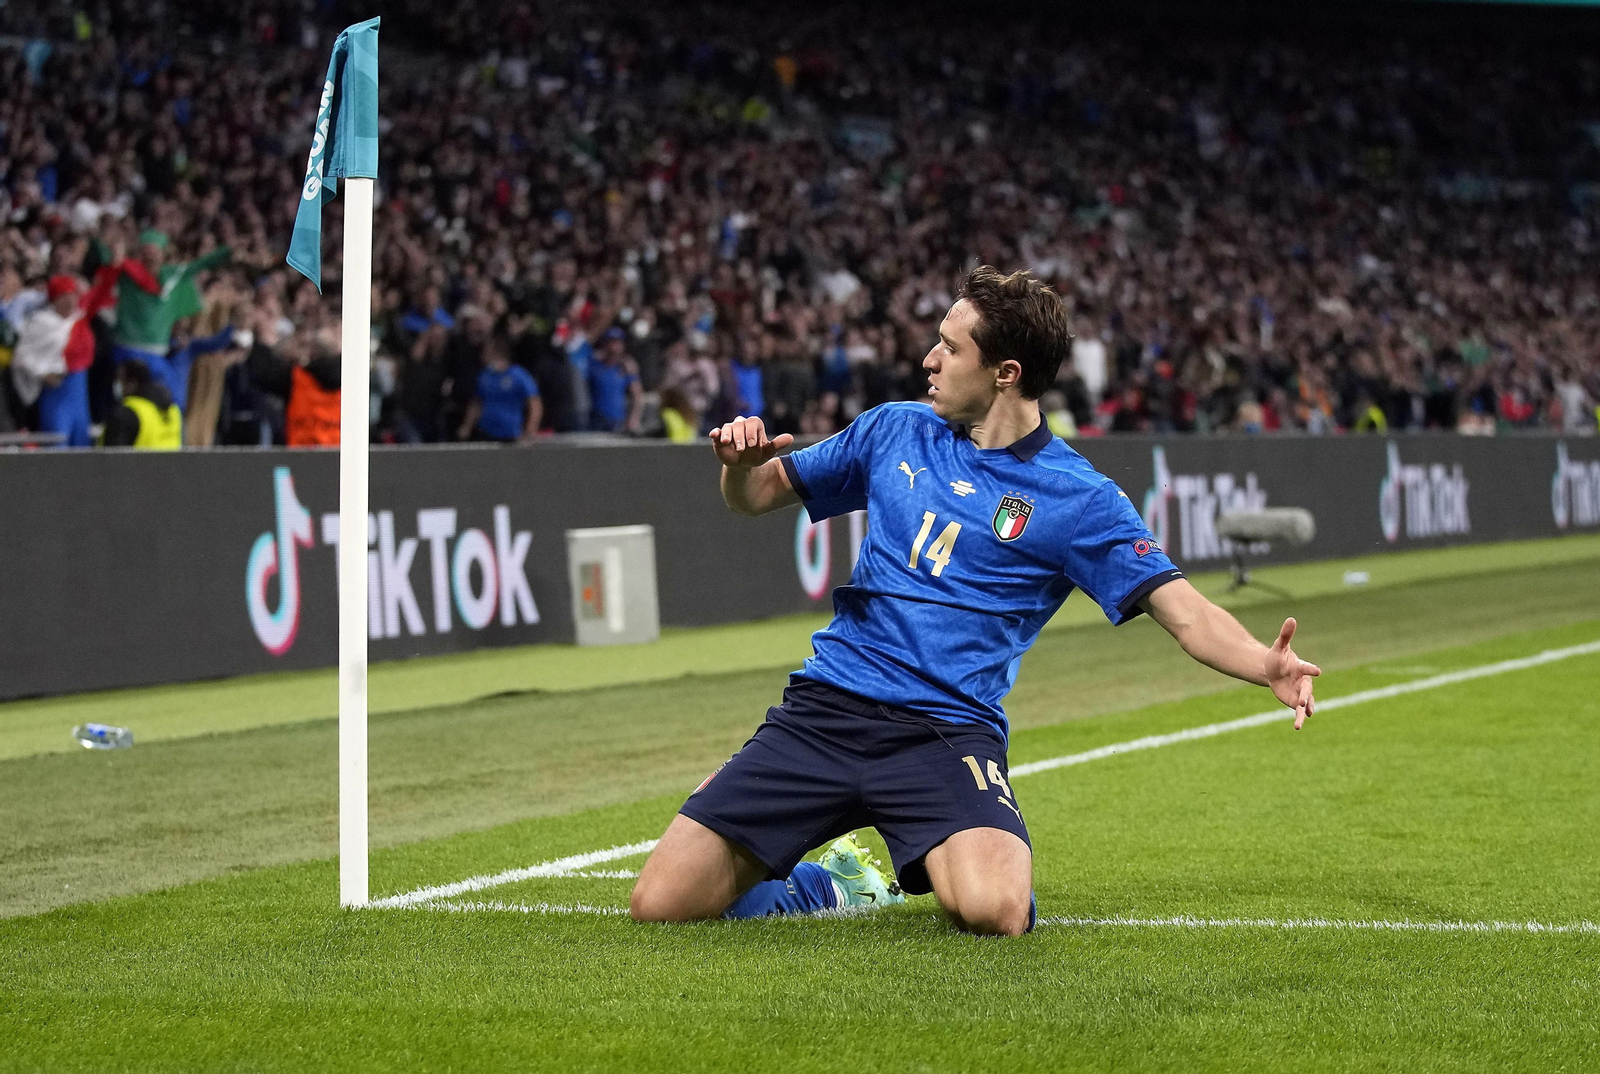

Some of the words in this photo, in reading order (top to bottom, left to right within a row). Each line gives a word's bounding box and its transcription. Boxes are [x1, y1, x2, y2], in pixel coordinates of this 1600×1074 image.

[1003, 499, 1030, 514] ITALIA
[908, 510, 962, 578] 14
[961, 755, 1012, 800] 14
